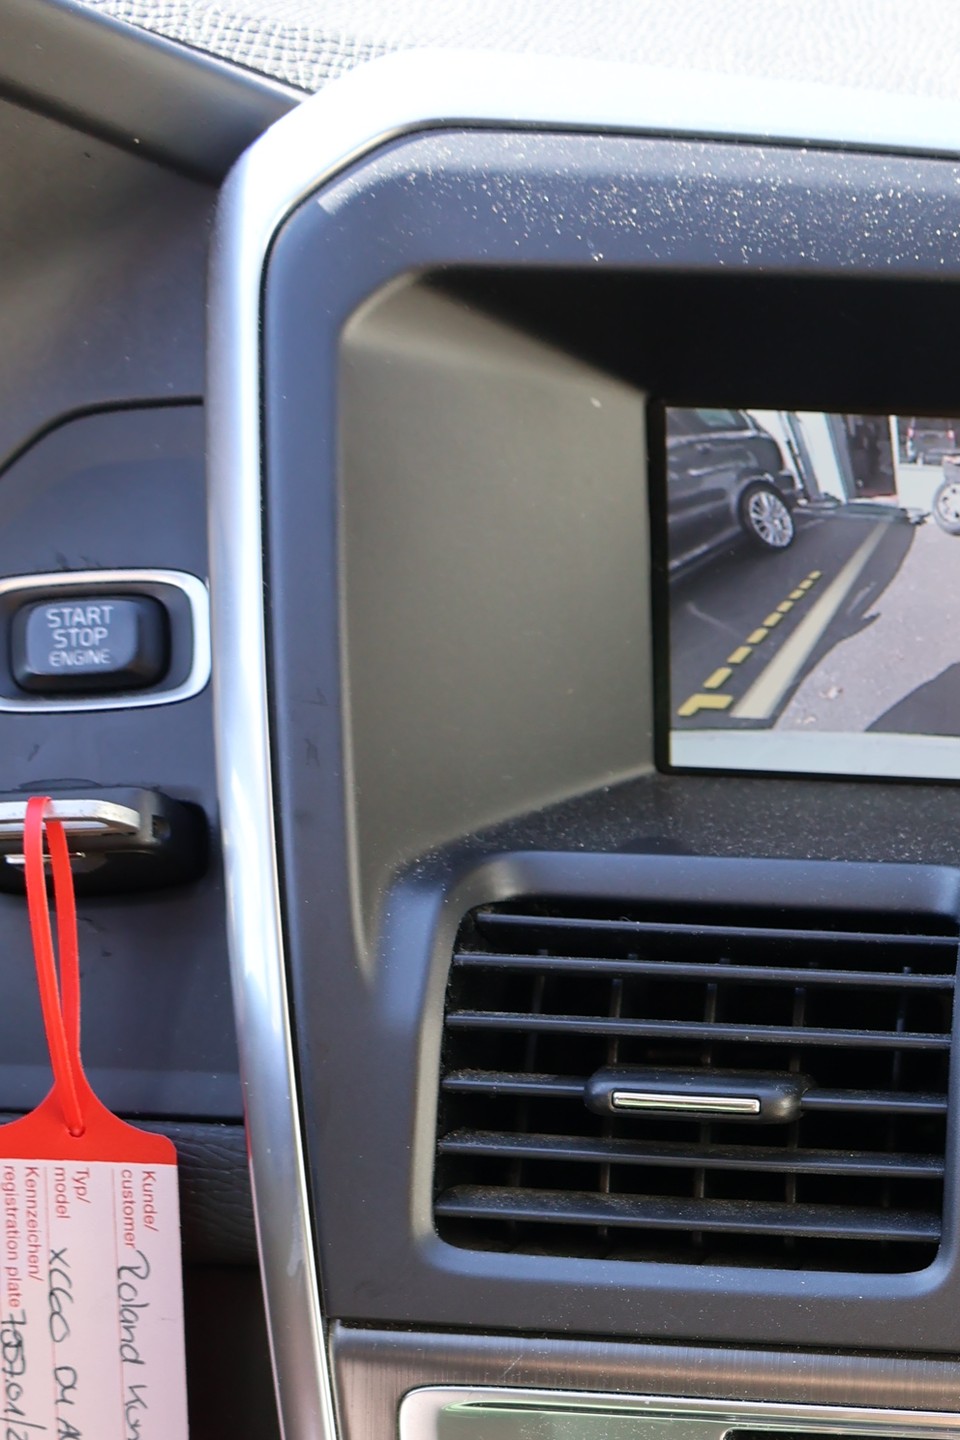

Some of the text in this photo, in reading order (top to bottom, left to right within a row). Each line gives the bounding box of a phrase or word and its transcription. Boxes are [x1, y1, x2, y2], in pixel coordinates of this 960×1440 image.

[46, 605, 114, 628] START
[53, 627, 108, 649] STOP
[49, 649, 111, 667] ENGINE
[54, 1166, 70, 1219] model
[73, 1166, 91, 1204] Typ/
[121, 1169, 137, 1249] customer
[142, 1170, 158, 1232] Kunde/
[2, 1166, 22, 1308] registration plate
[24, 1166, 45, 1281] Kennzeichen/
